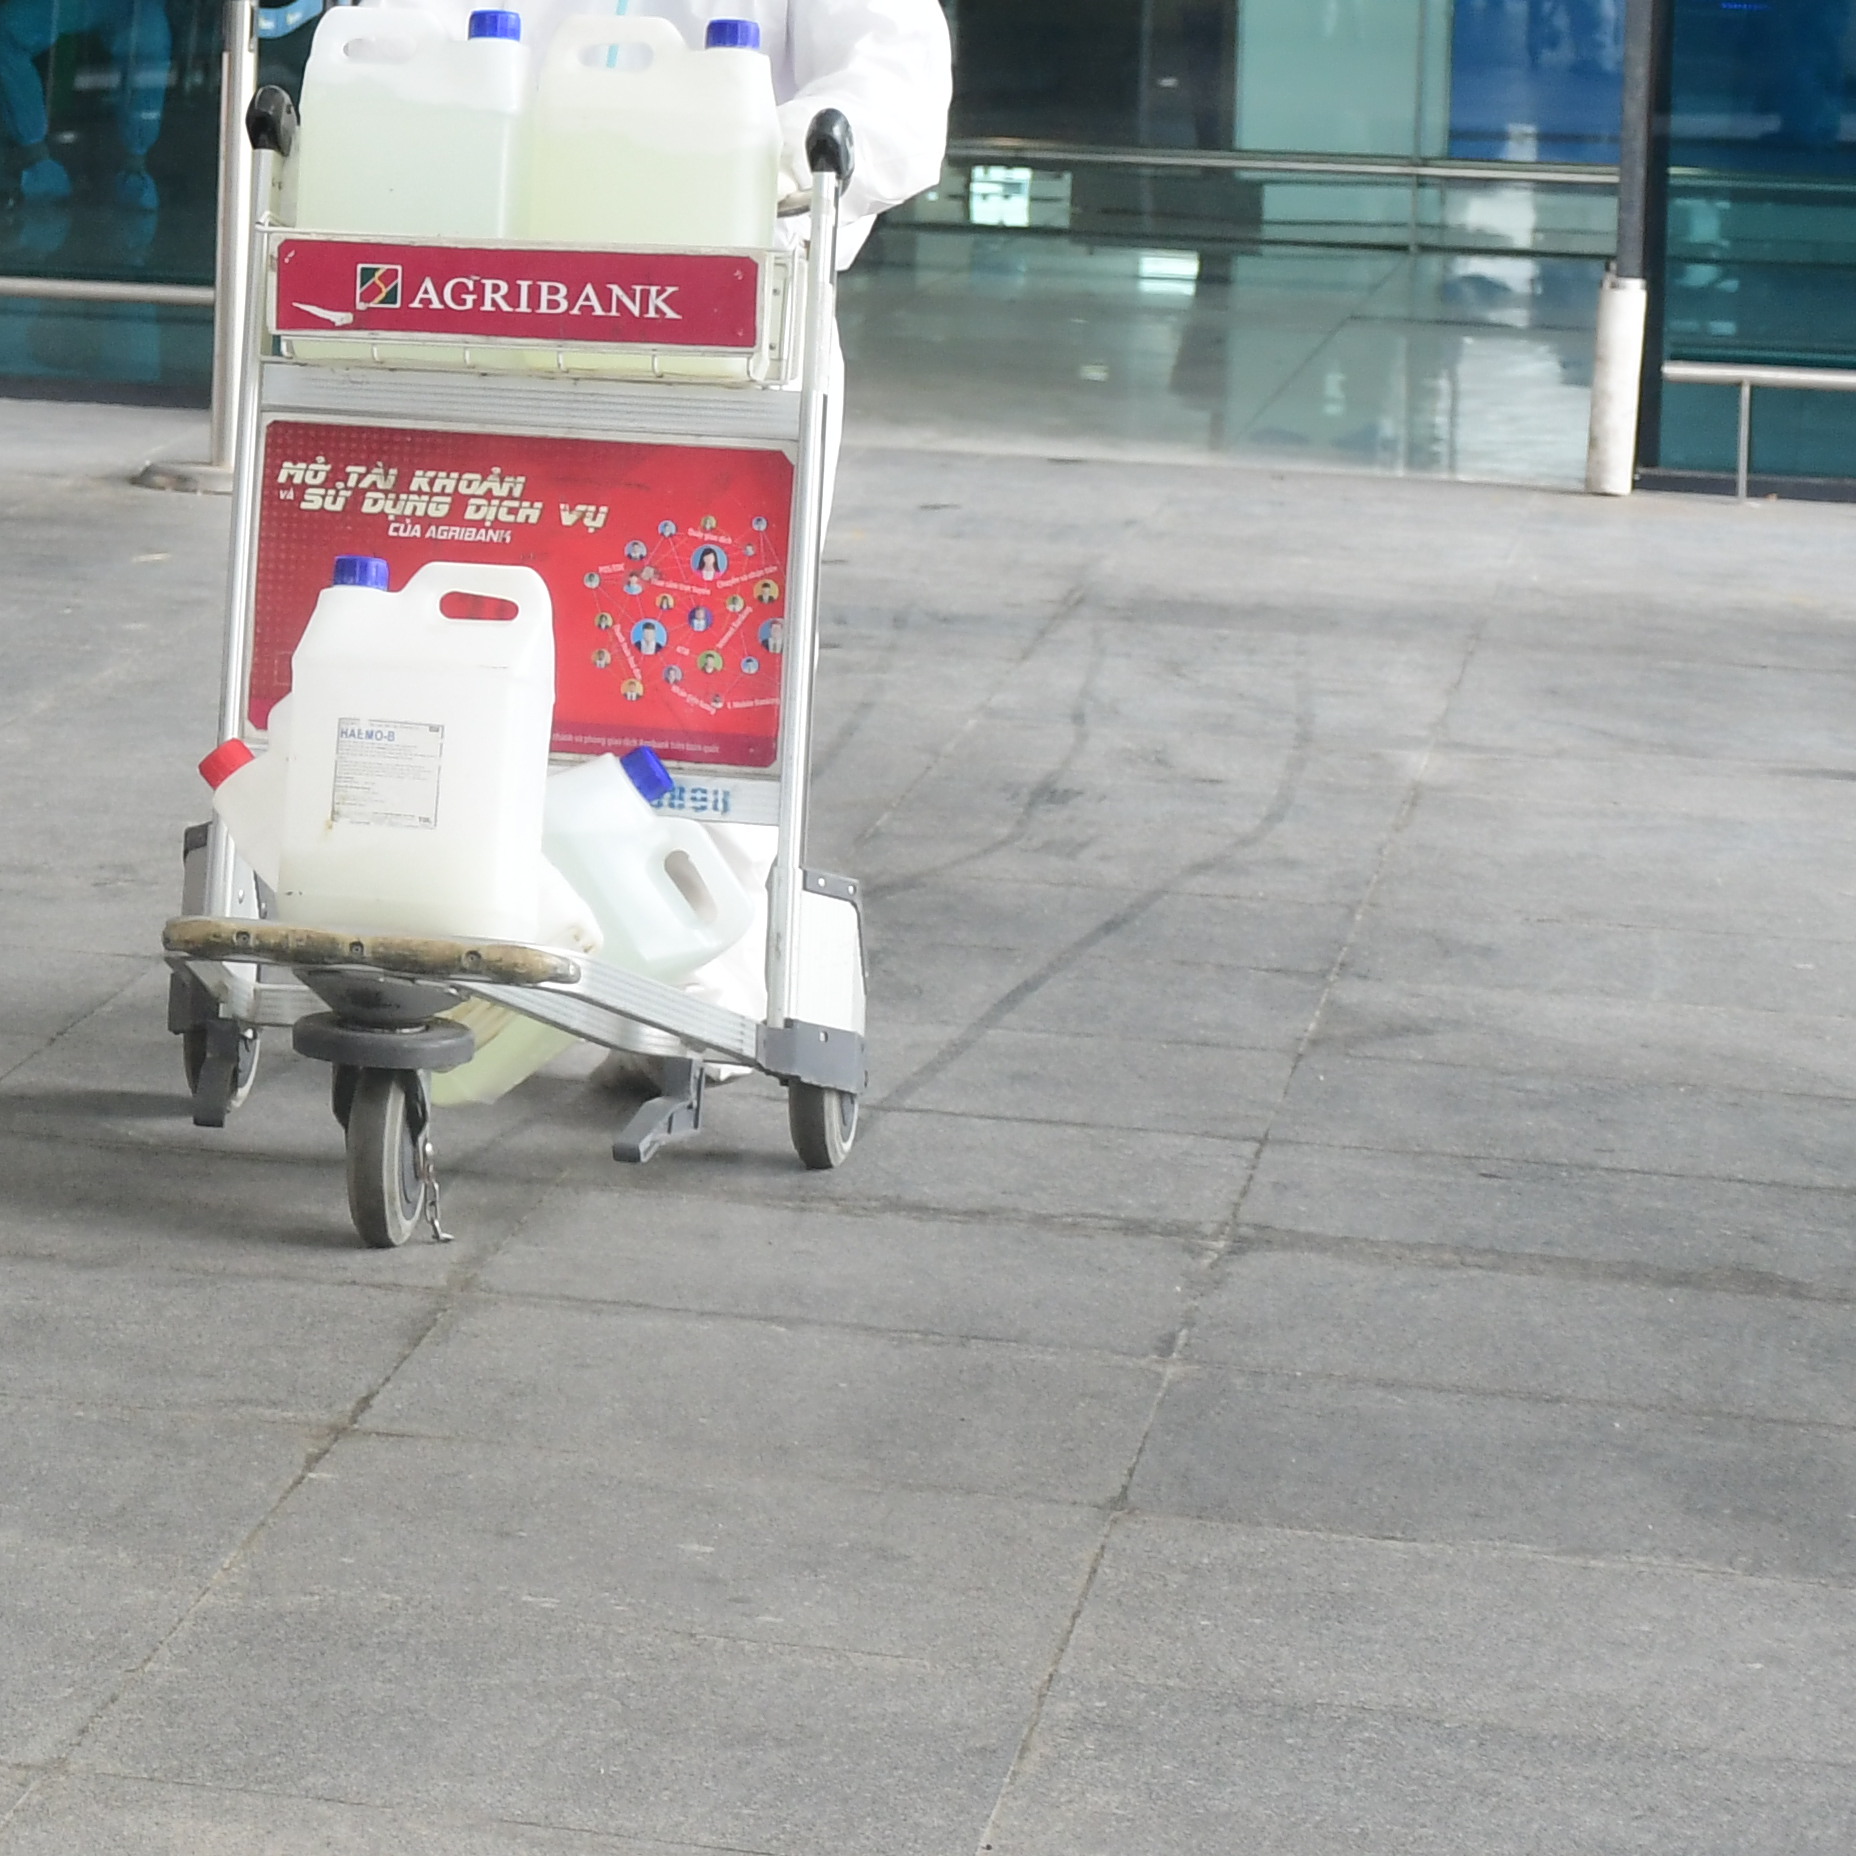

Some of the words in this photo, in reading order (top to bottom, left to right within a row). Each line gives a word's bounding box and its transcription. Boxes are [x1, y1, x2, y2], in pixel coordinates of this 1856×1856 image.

[408, 275, 683, 321] AGRIBANK
[276, 455, 333, 486] MỞ
[344, 460, 400, 491] TÀI
[409, 466, 527, 499] KHOẢN
[360, 491, 452, 521] DỤNG
[463, 496, 544, 527] DỊCH
[558, 501, 611, 534] VỤ
[386, 517, 422, 540] CỦA
[424, 524, 513, 544] AGRIBANK
